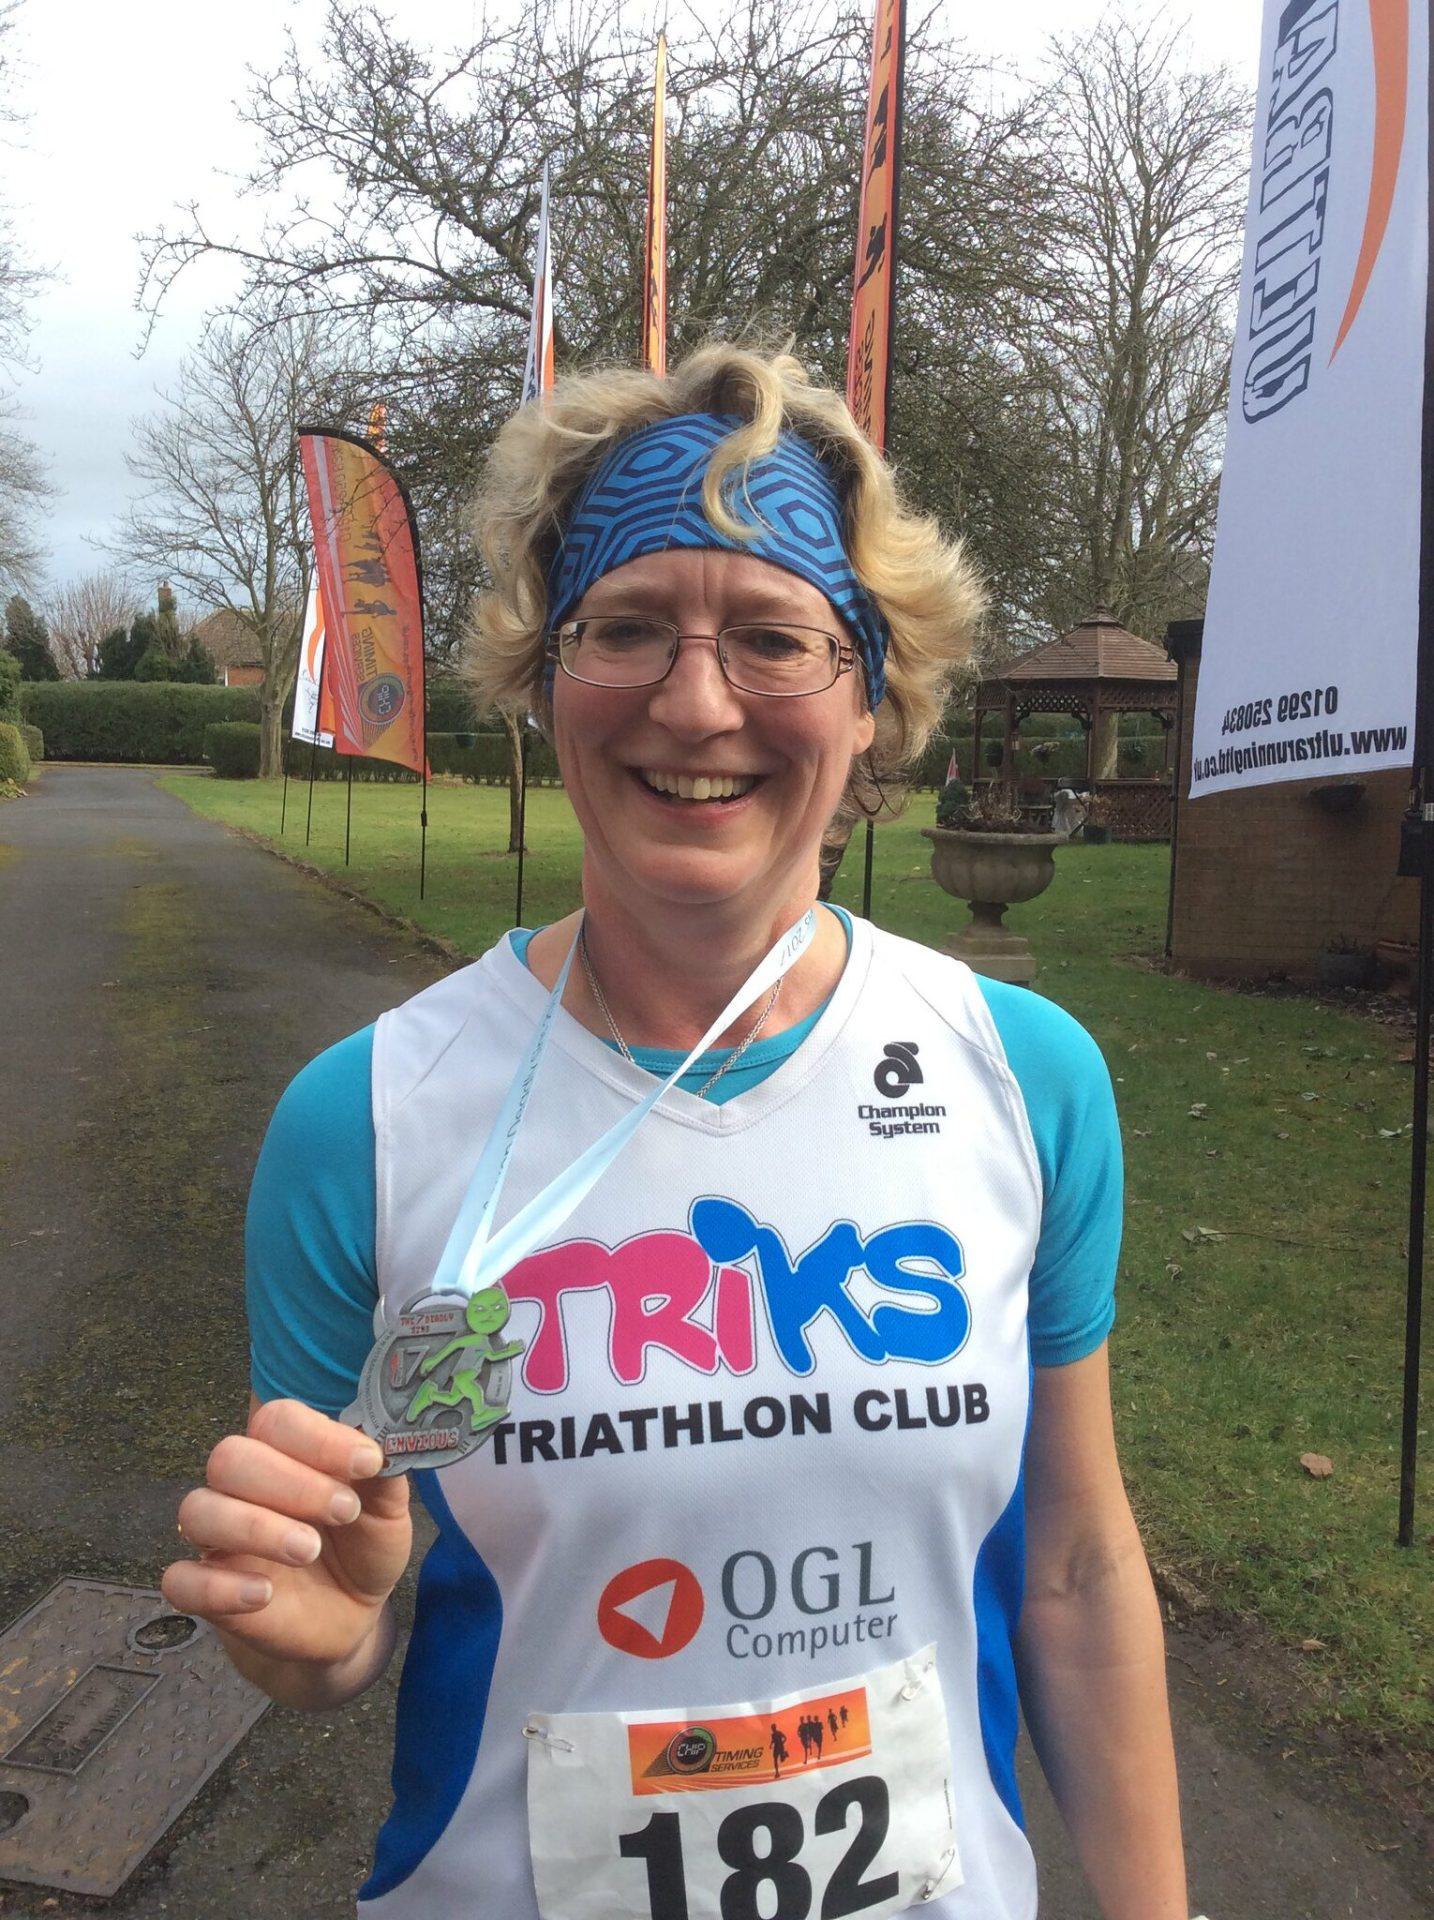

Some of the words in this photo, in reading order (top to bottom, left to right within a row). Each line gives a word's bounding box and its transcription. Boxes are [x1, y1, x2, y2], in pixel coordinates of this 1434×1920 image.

[858, 1103, 947, 1120] Champion
[869, 1121, 940, 1139] System
[493, 1393, 832, 1466] TRIATHLON
[854, 1383, 991, 1432] CLUB
[385, 1428, 460, 1455] ENVIOUS
[721, 1541, 895, 1620] OGL
[726, 1613, 899, 1659] Computer
[711, 1761, 760, 1773] SERVICES
[716, 1747, 764, 1761] TIMING
[619, 1775, 899, 1920] 182
